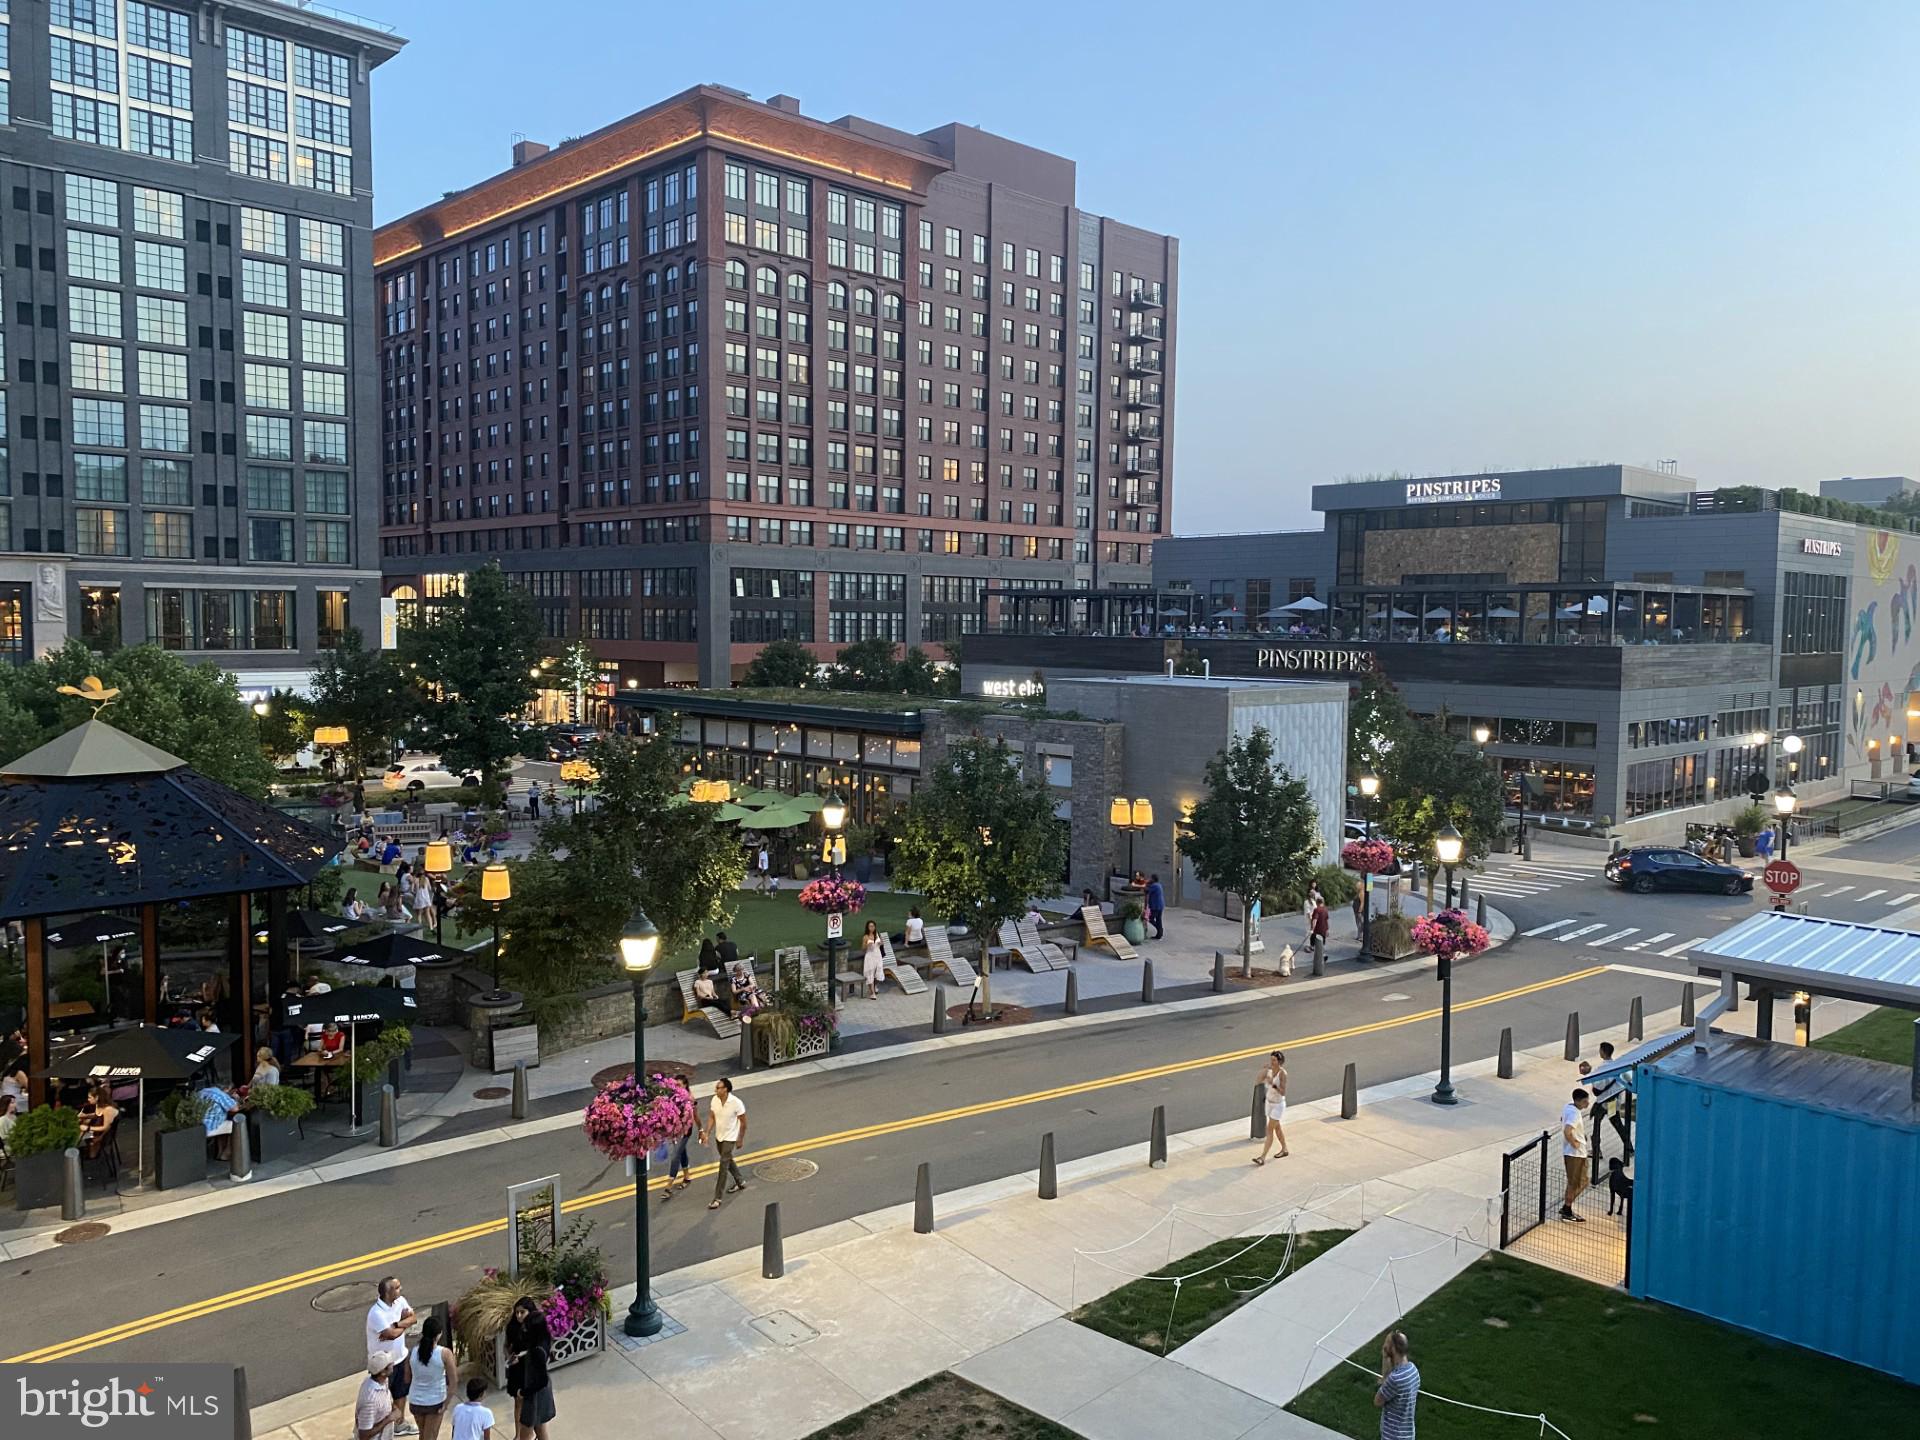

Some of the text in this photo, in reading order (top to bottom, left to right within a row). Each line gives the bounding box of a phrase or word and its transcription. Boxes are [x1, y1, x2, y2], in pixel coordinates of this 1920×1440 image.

[1406, 479, 1501, 497] PINSTRIPES
[1257, 649, 1374, 672] PINSTRIPES
[983, 680, 1016, 696] west
[1765, 870, 1799, 885] STOP
